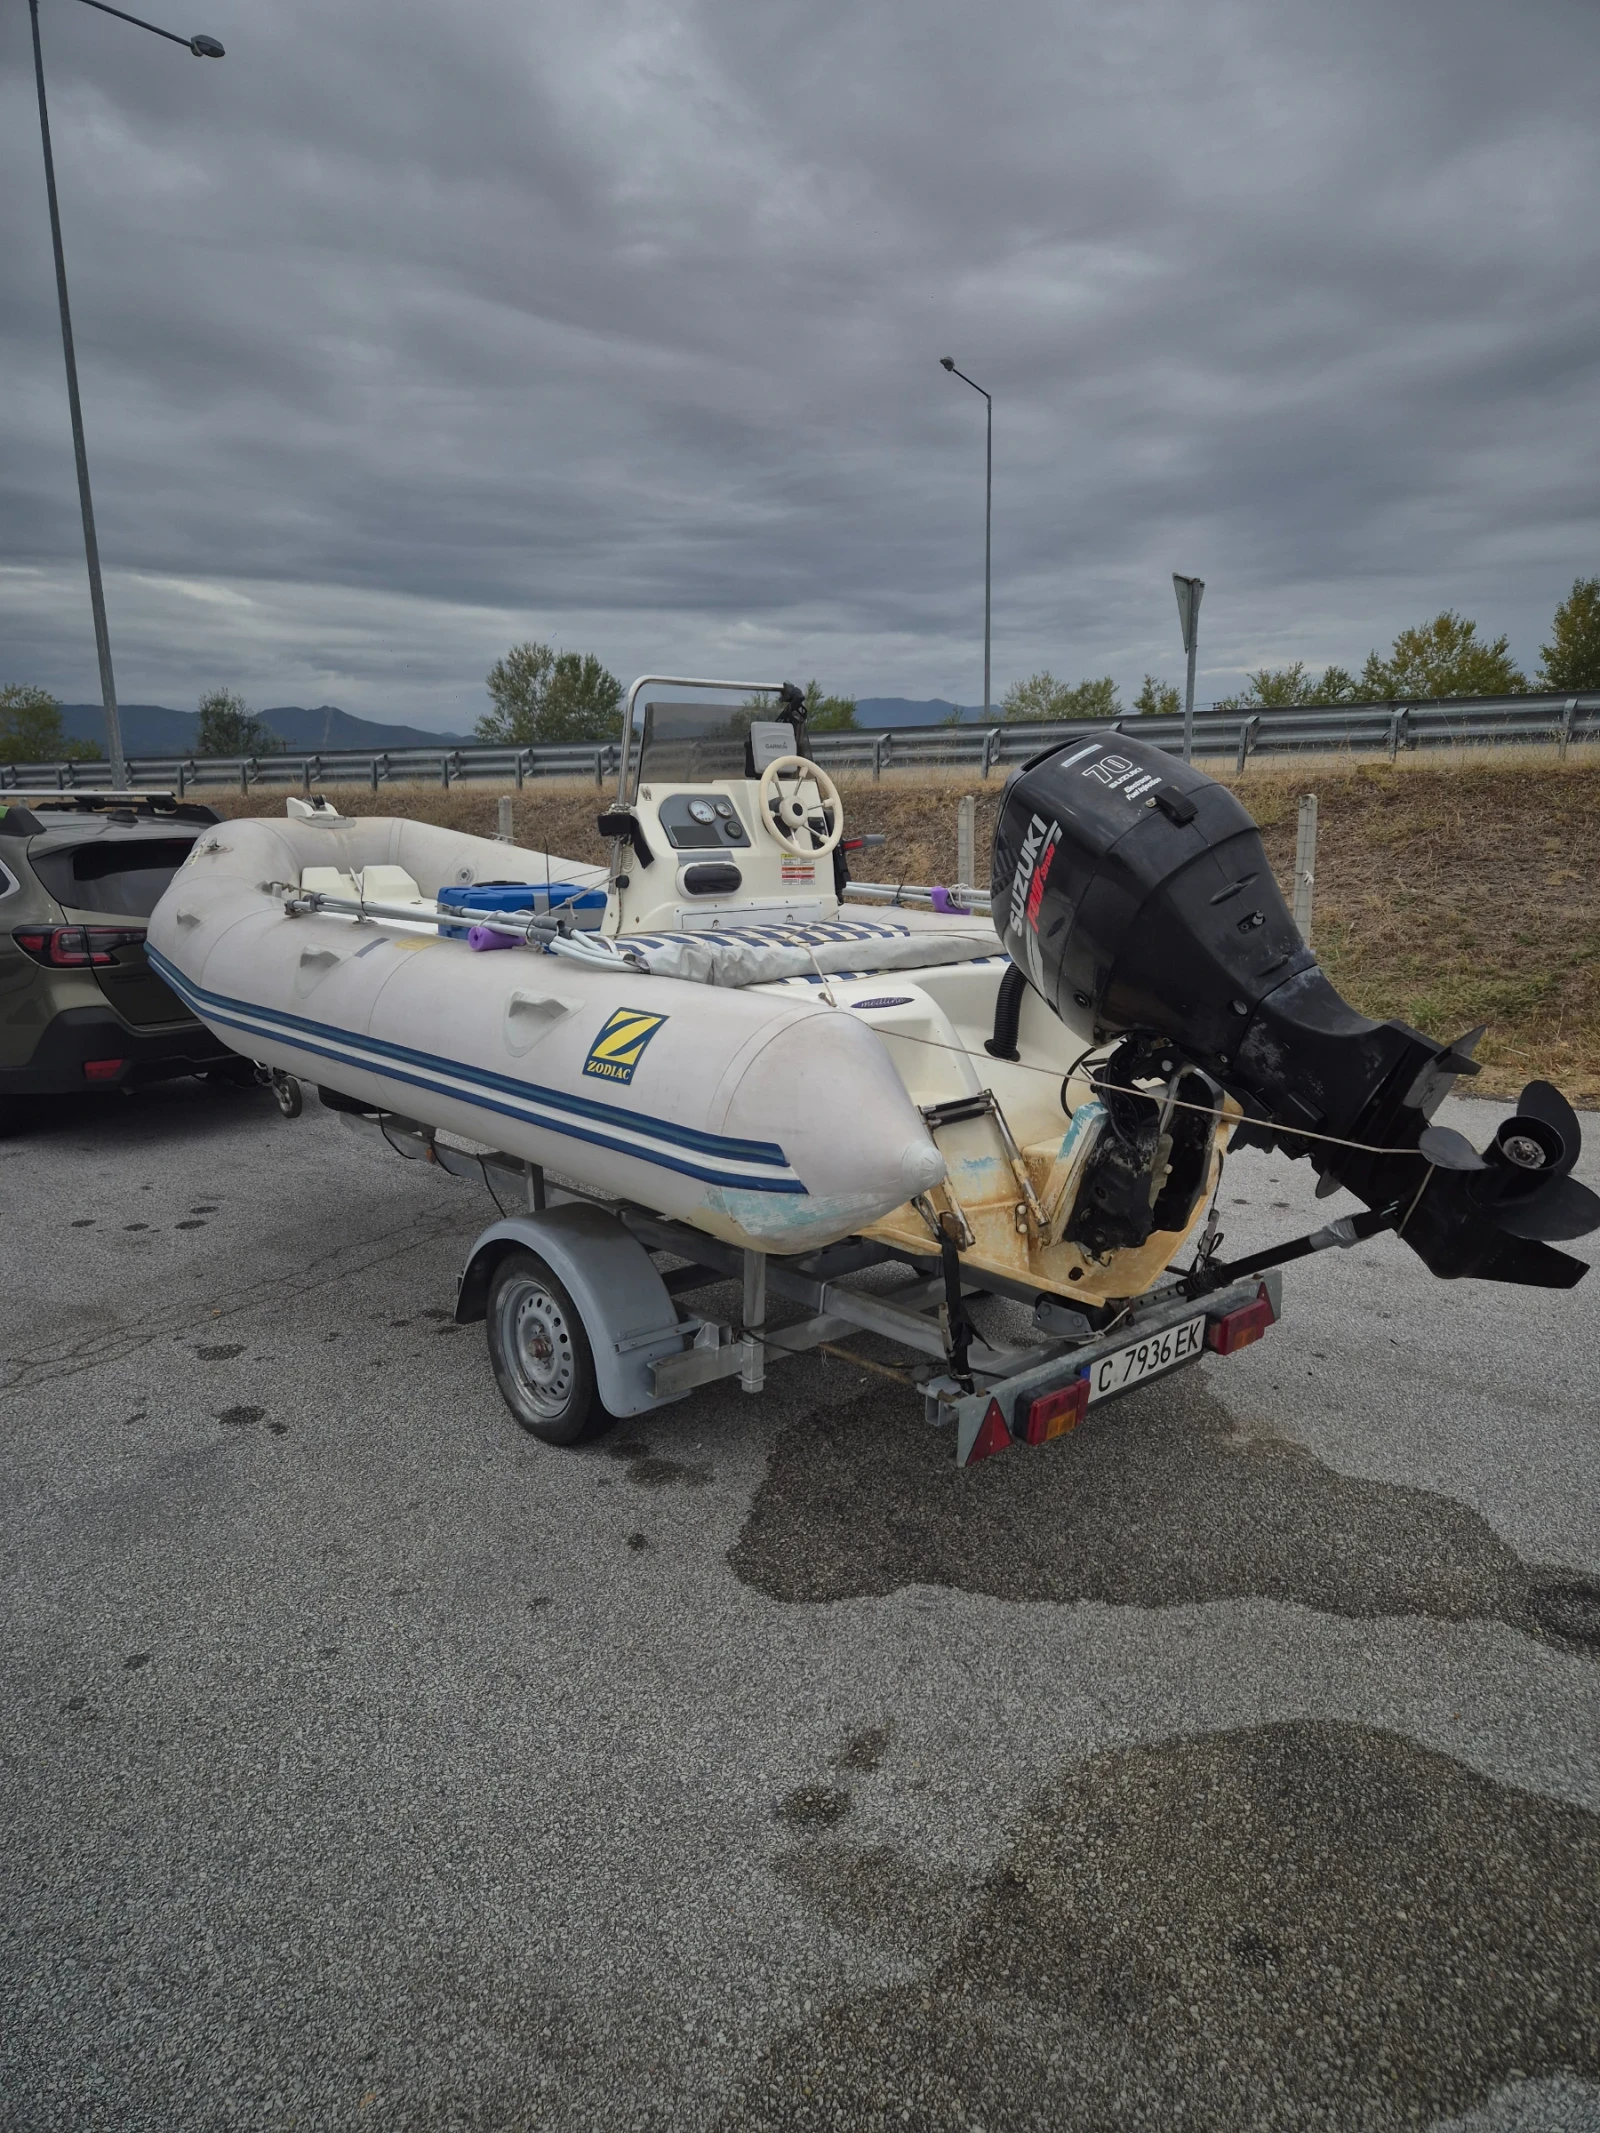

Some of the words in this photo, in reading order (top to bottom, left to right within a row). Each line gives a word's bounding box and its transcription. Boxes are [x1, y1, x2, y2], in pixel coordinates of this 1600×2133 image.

[1081, 755, 1133, 784] 70
[1108, 767, 1143, 789] SUZUKI
[1010, 813, 1048, 937] SUZUKI
[587, 1060, 631, 1080] ZODIAC
[1123, 1334, 1171, 1382] 7936
